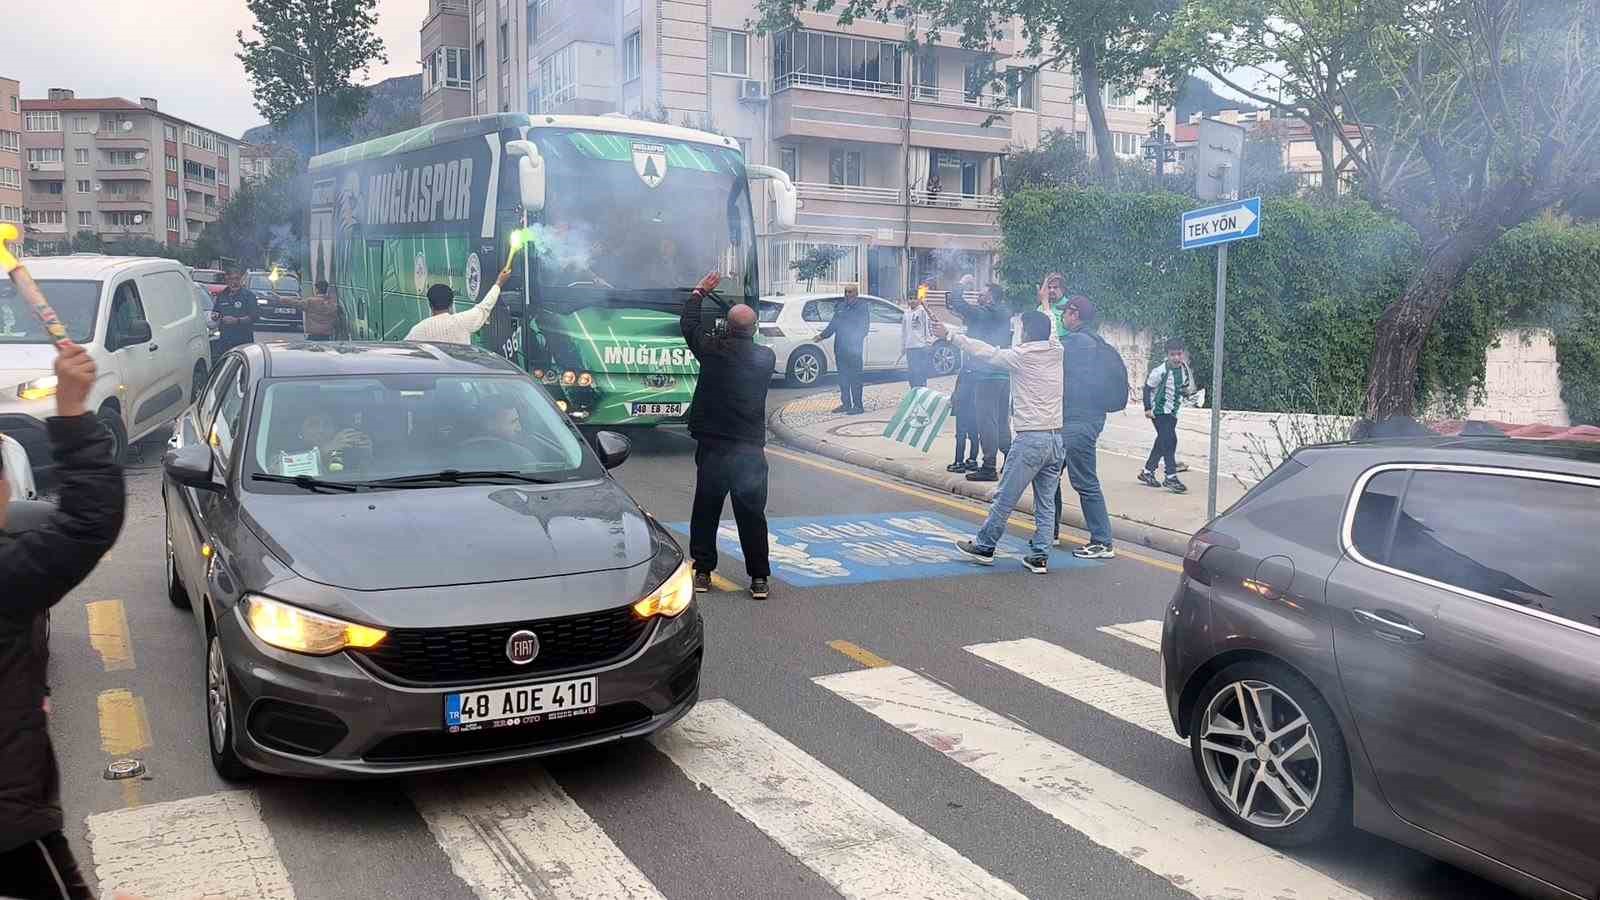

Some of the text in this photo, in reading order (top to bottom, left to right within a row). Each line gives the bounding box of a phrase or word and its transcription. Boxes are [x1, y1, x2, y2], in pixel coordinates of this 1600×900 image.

[367, 157, 473, 225] MUĞLASPOR
[1188, 215, 1237, 238] TEK YÖN
[502, 325, 522, 360] 1967
[514, 640, 534, 657] FIAT
[461, 694, 490, 719] 48
[502, 688, 543, 714] ADE
[552, 681, 592, 707] 410
[449, 711, 460, 719] TR
